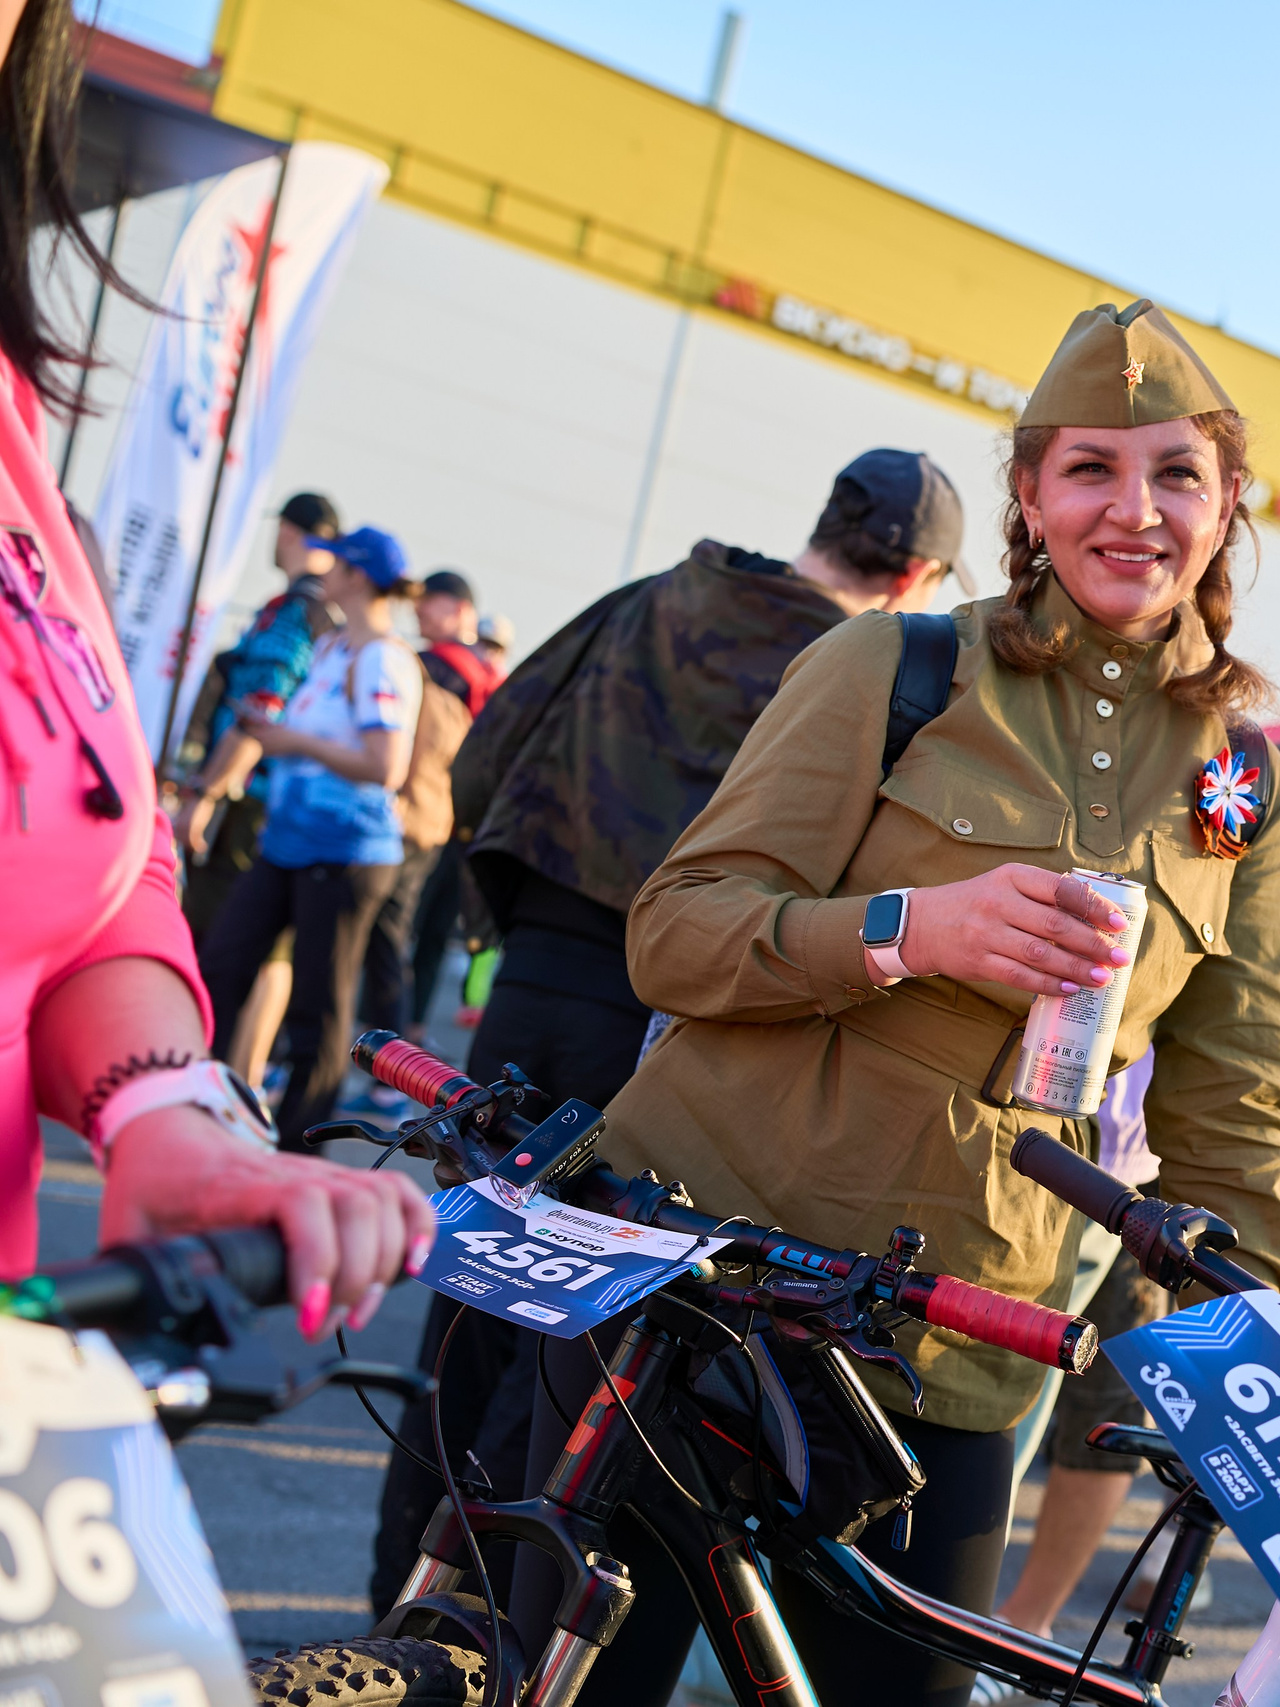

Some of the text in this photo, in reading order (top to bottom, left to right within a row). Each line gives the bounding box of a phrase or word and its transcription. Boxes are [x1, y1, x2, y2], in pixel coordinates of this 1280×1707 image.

[569, 1147, 582, 1161] FOR
[584, 1130, 600, 1147] RACE
[547, 1208, 647, 1240] фонтанка.ру 25
[548, 1233, 605, 1252] купер
[451, 1231, 616, 1292] 4561
[457, 1256, 536, 1290] «ЗАСВЕТИ ЗСД»
[457, 1274, 494, 1290] СТАРТ
[783, 1281, 819, 1289] SHIMANO
[1224, 1414, 1276, 1478] «ЗАСВЕТИ
[1208, 1456, 1247, 1502] В 20:30
[1219, 1453, 1256, 1494] СТАРТ
[1164, 1570, 1195, 1633] CUBE
